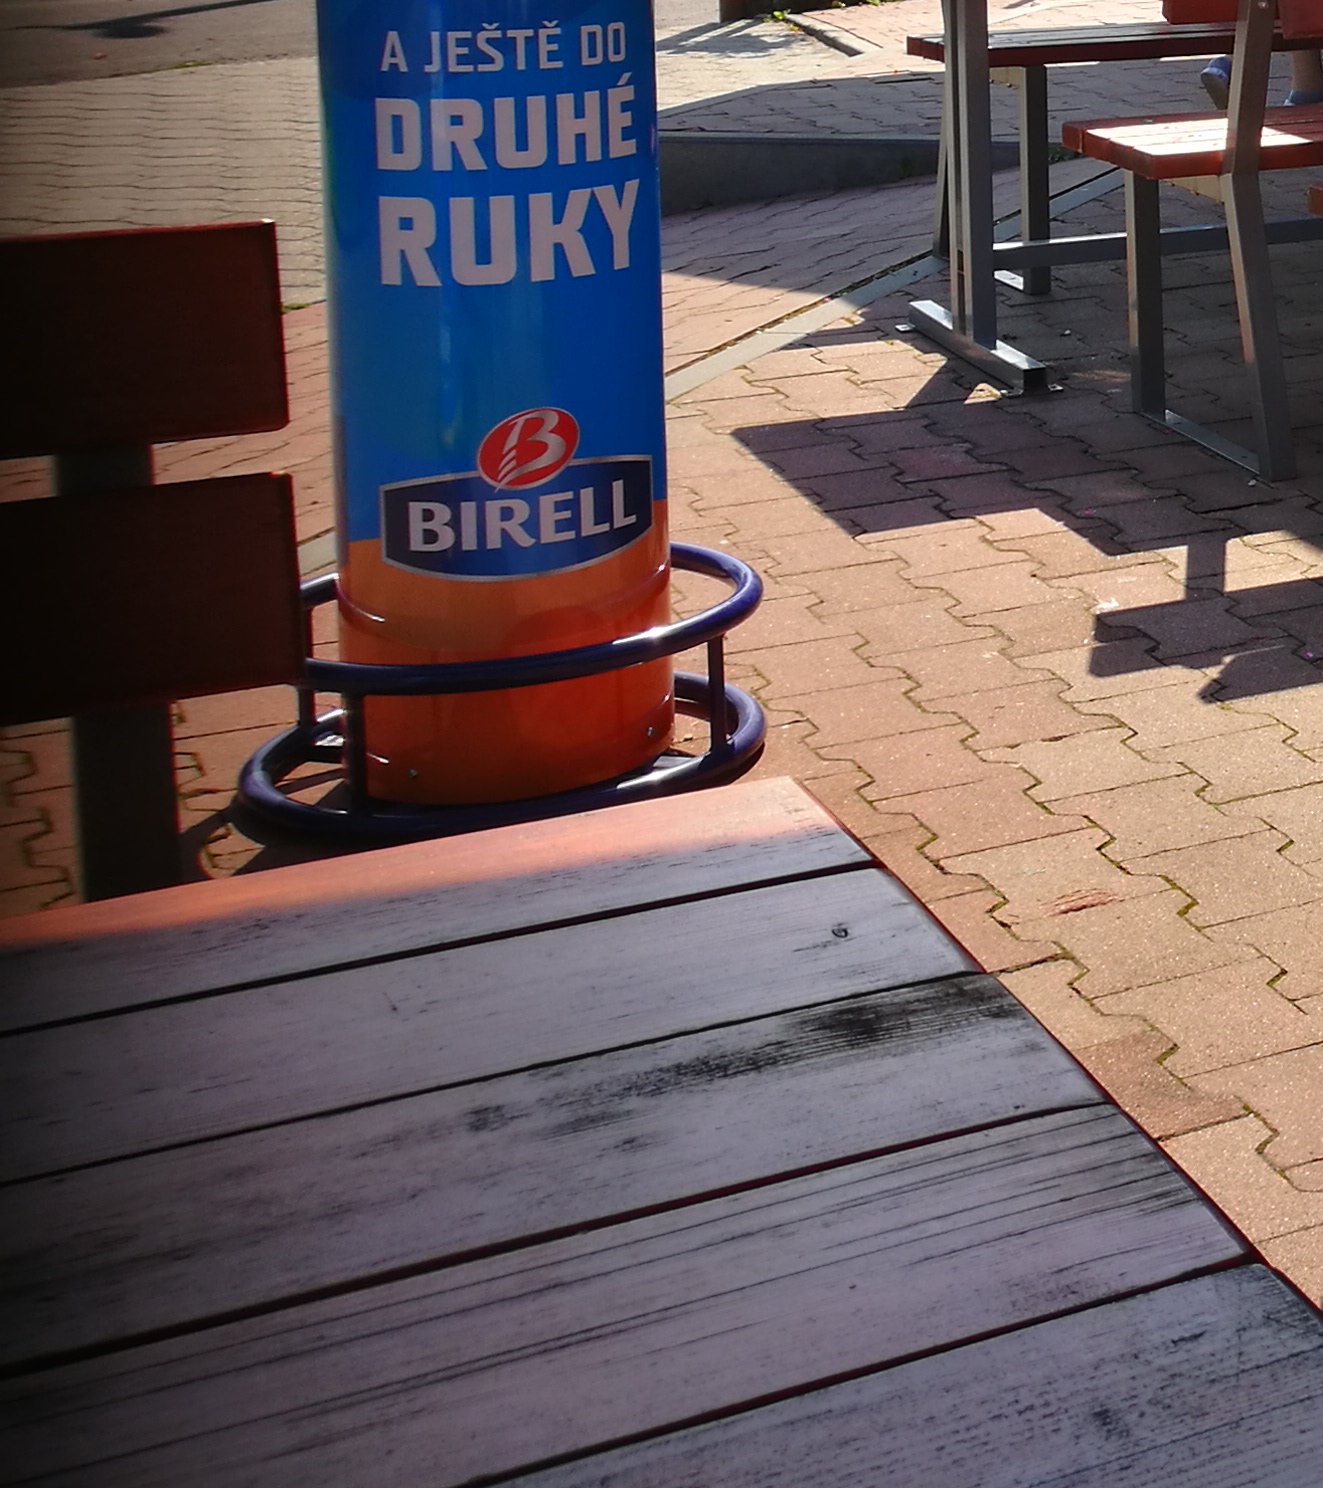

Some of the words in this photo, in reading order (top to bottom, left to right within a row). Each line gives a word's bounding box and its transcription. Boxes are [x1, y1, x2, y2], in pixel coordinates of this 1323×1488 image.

[380, 29, 408, 73] A
[424, 20, 564, 74] JEŠTĚ
[579, 22, 628, 67] DO
[375, 72, 639, 172] DRUHÉ
[378, 179, 641, 288] RUKY
[407, 478, 639, 554] BIRELL
